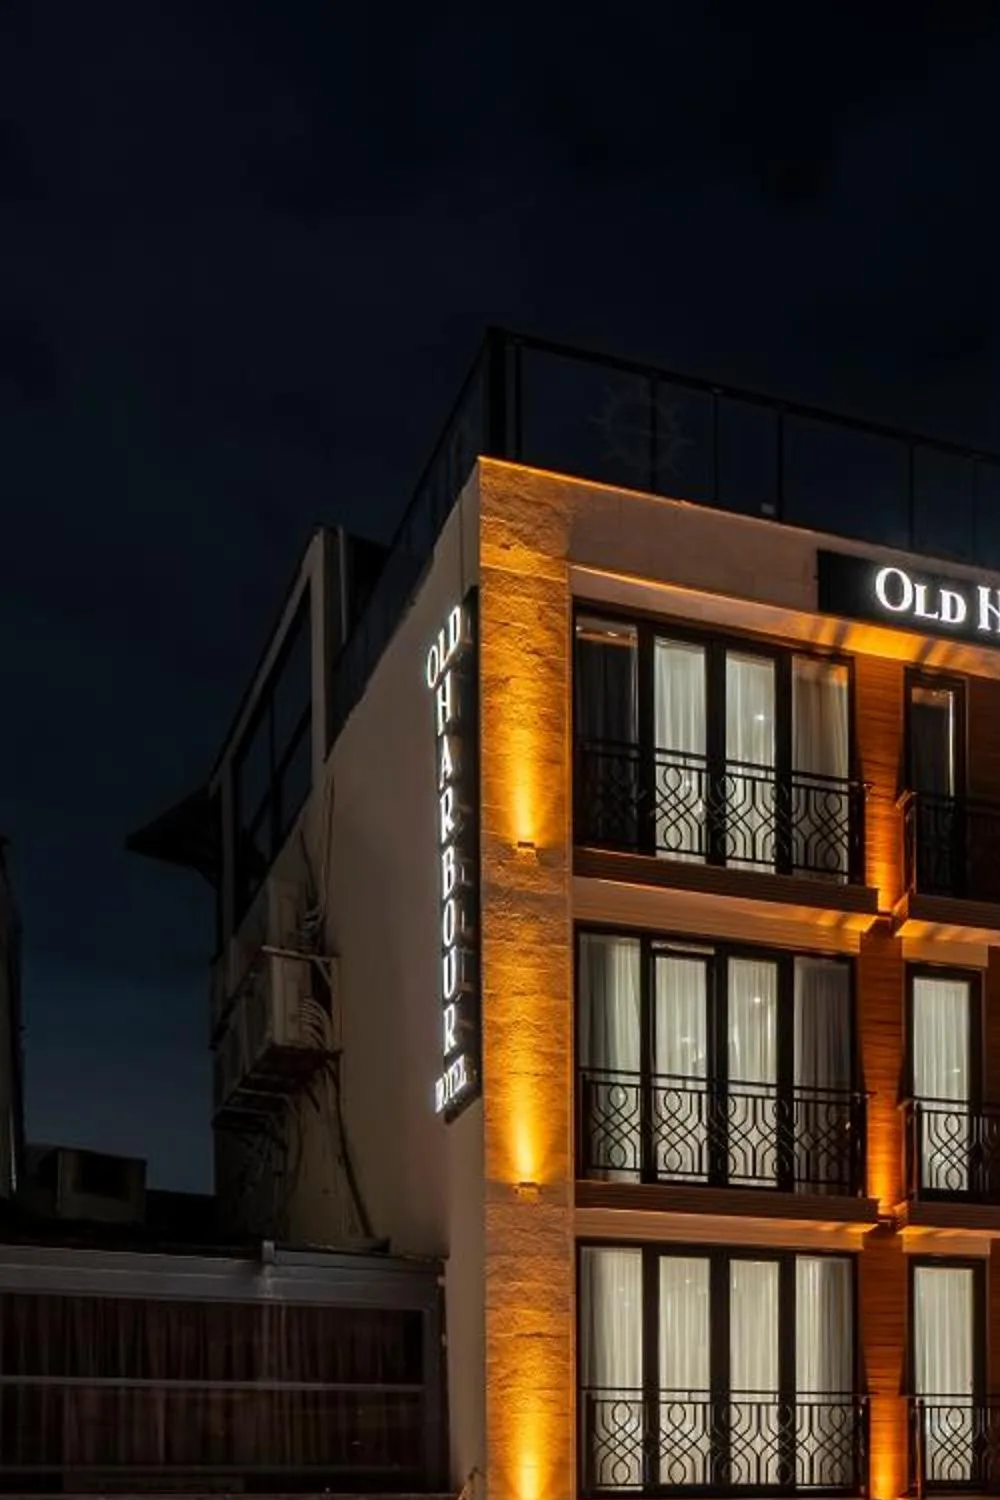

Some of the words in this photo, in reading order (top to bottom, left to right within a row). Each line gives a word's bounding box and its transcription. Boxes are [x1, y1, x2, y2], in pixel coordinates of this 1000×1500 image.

[874, 566, 966, 624] OLD
[427, 605, 461, 689] OLD
[437, 669, 457, 1057] HARBOUR
